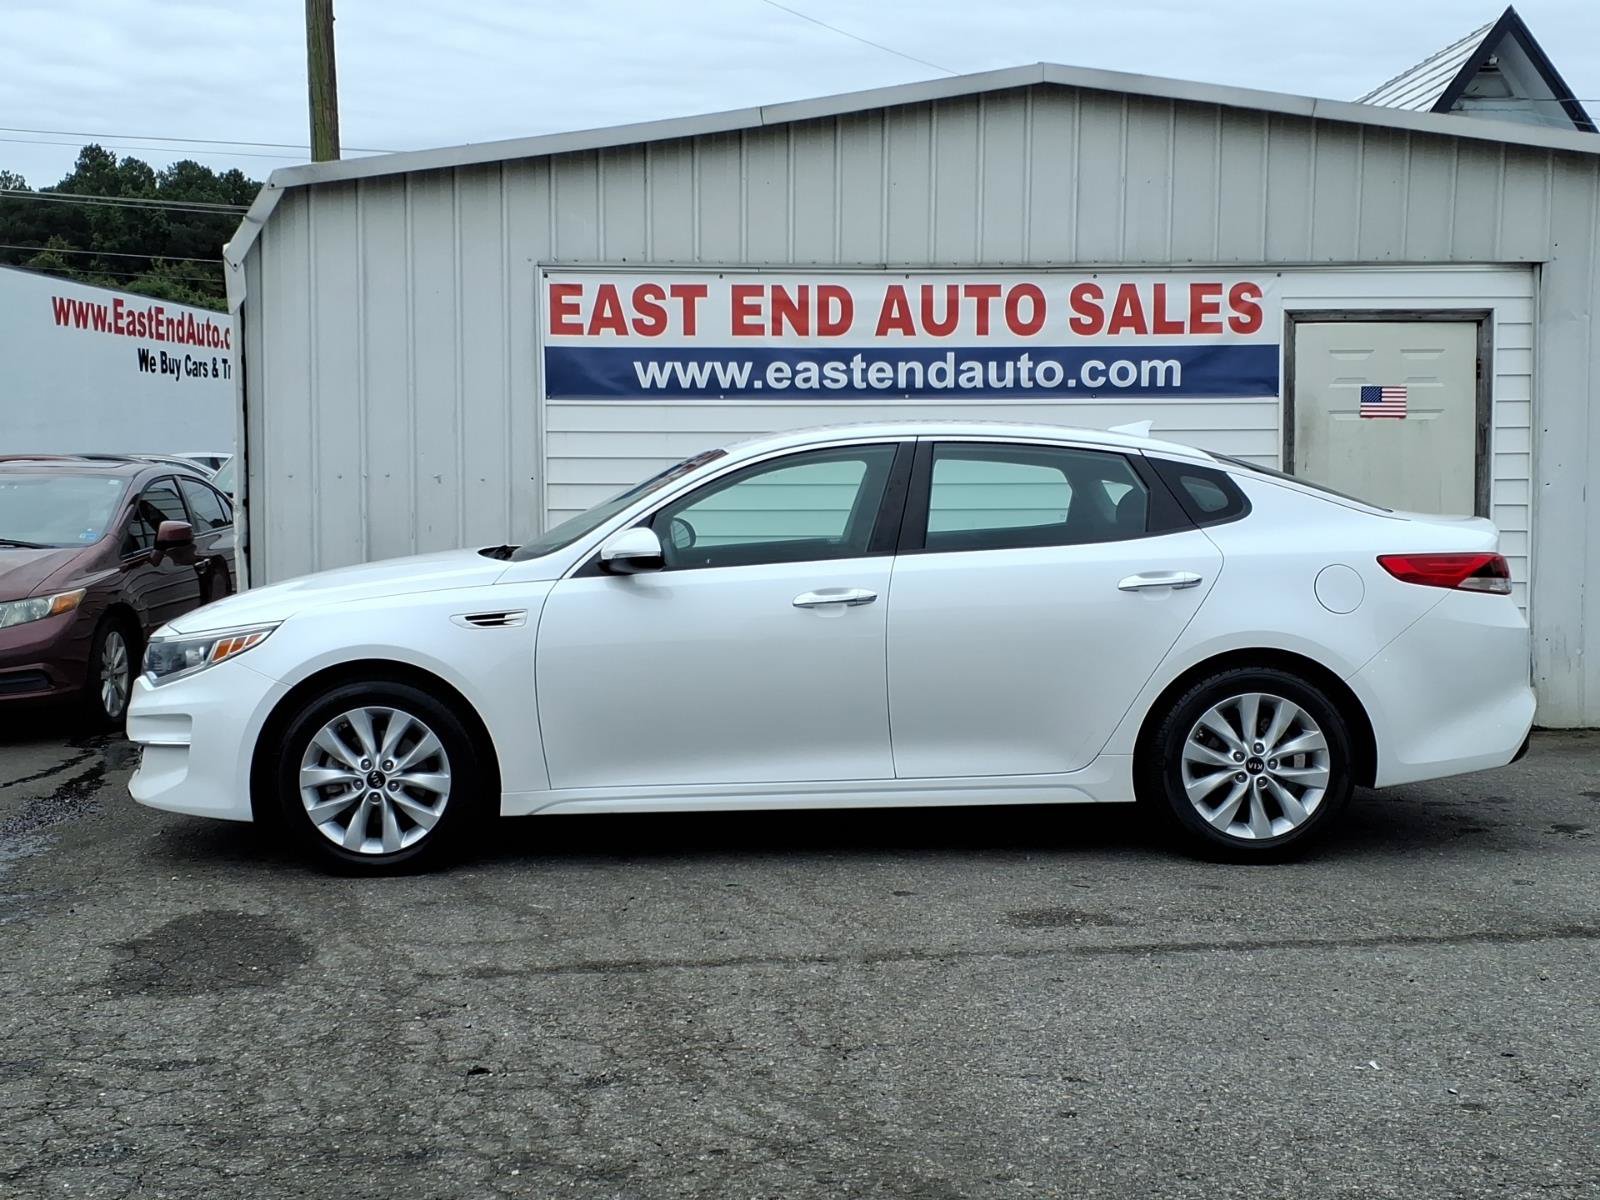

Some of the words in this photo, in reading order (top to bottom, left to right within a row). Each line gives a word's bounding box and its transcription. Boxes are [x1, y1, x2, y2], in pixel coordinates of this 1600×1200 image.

[549, 283, 708, 337] EAST
[731, 284, 854, 337] END
[875, 282, 1047, 337] AUTO
[1069, 281, 1263, 336] SALES
[137, 347, 157, 374] We
[160, 350, 181, 382] Buy
[184, 353, 208, 379] Cars
[211, 356, 219, 379] &
[633, 352, 1182, 389] www.eastendauto.com
